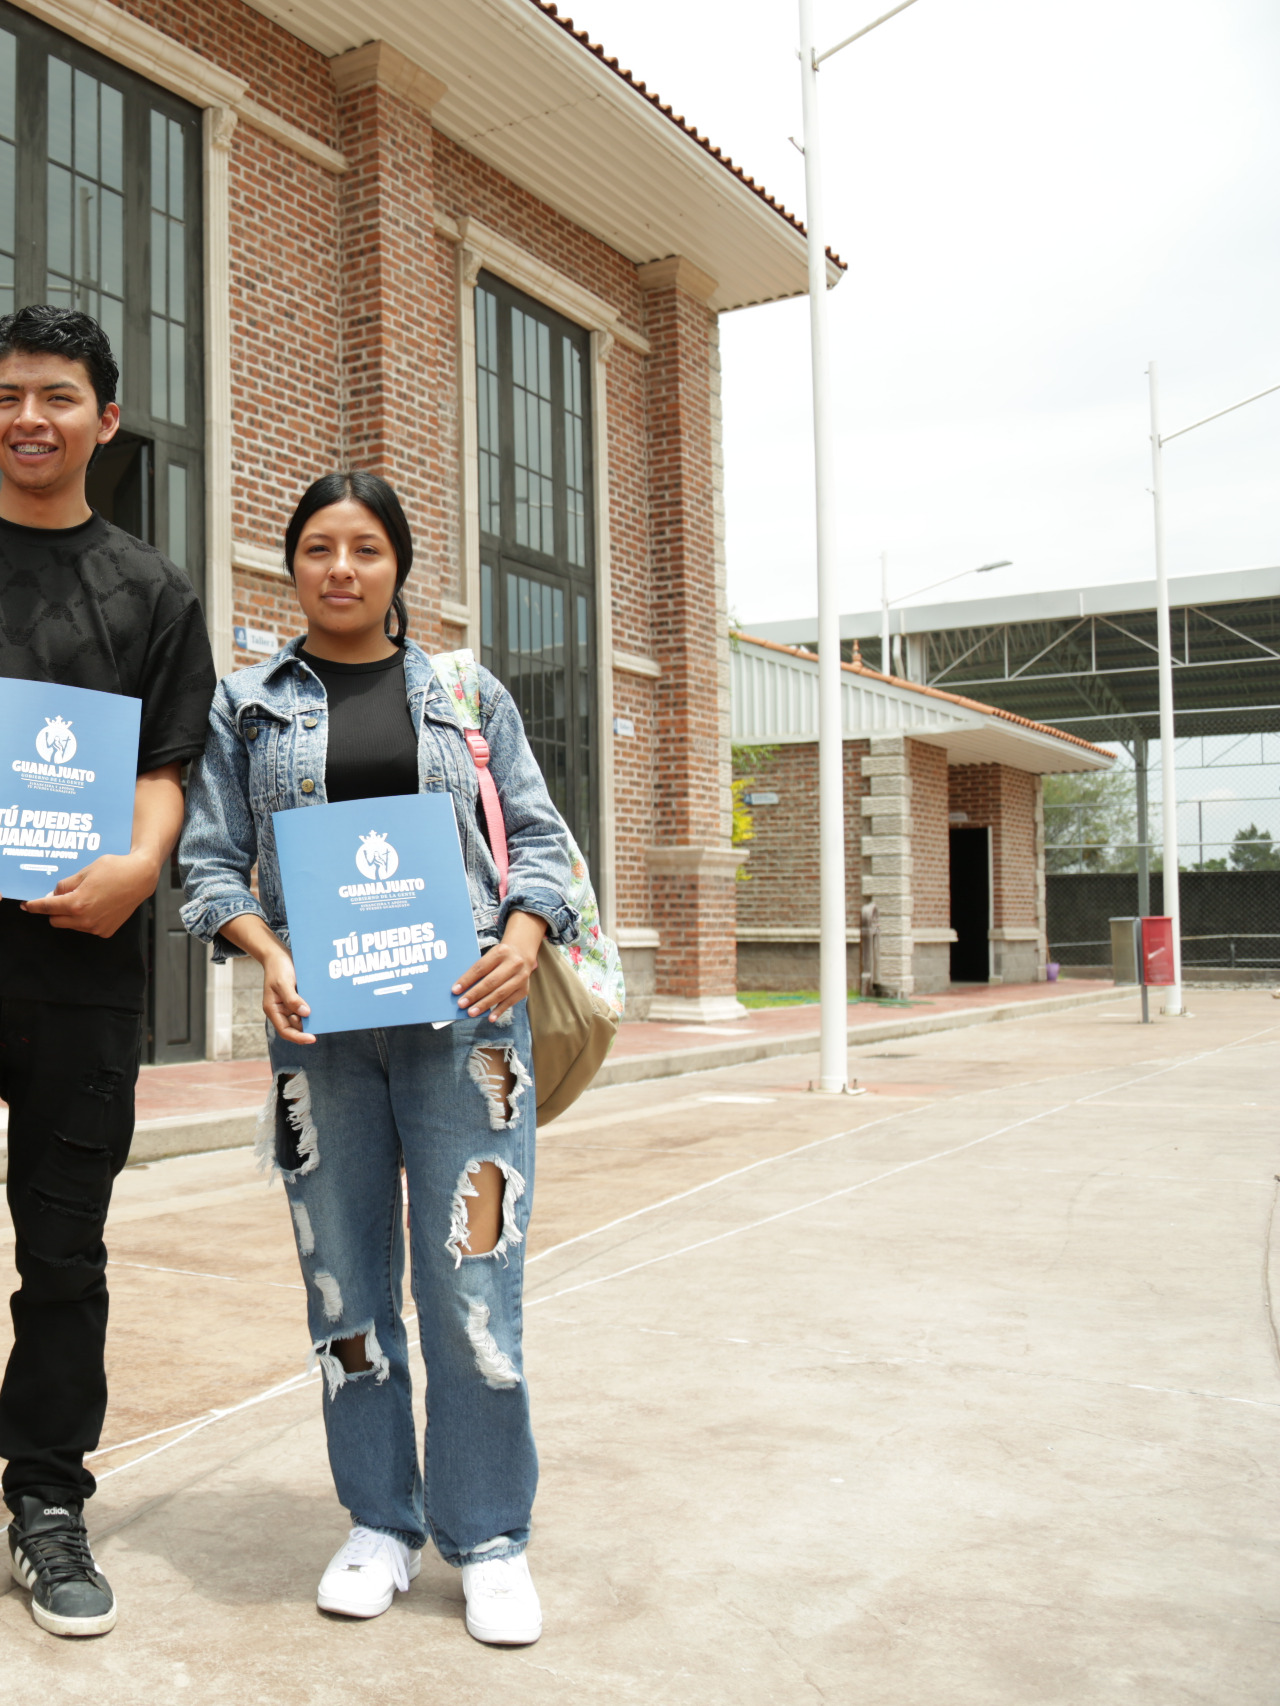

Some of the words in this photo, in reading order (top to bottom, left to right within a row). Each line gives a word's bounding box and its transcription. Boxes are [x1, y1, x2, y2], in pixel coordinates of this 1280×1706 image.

[11, 760, 95, 783] GUANAJUATO
[20, 809, 94, 832] PUEDES
[44, 850, 52, 858] Y
[338, 877, 425, 898] GUANAJUATO
[332, 931, 359, 958] TÚ
[361, 921, 435, 953] PUEDES
[328, 939, 448, 980] GUANAJUATO
[394, 969, 401, 977] Y
[43, 1506, 69, 1517] adida
